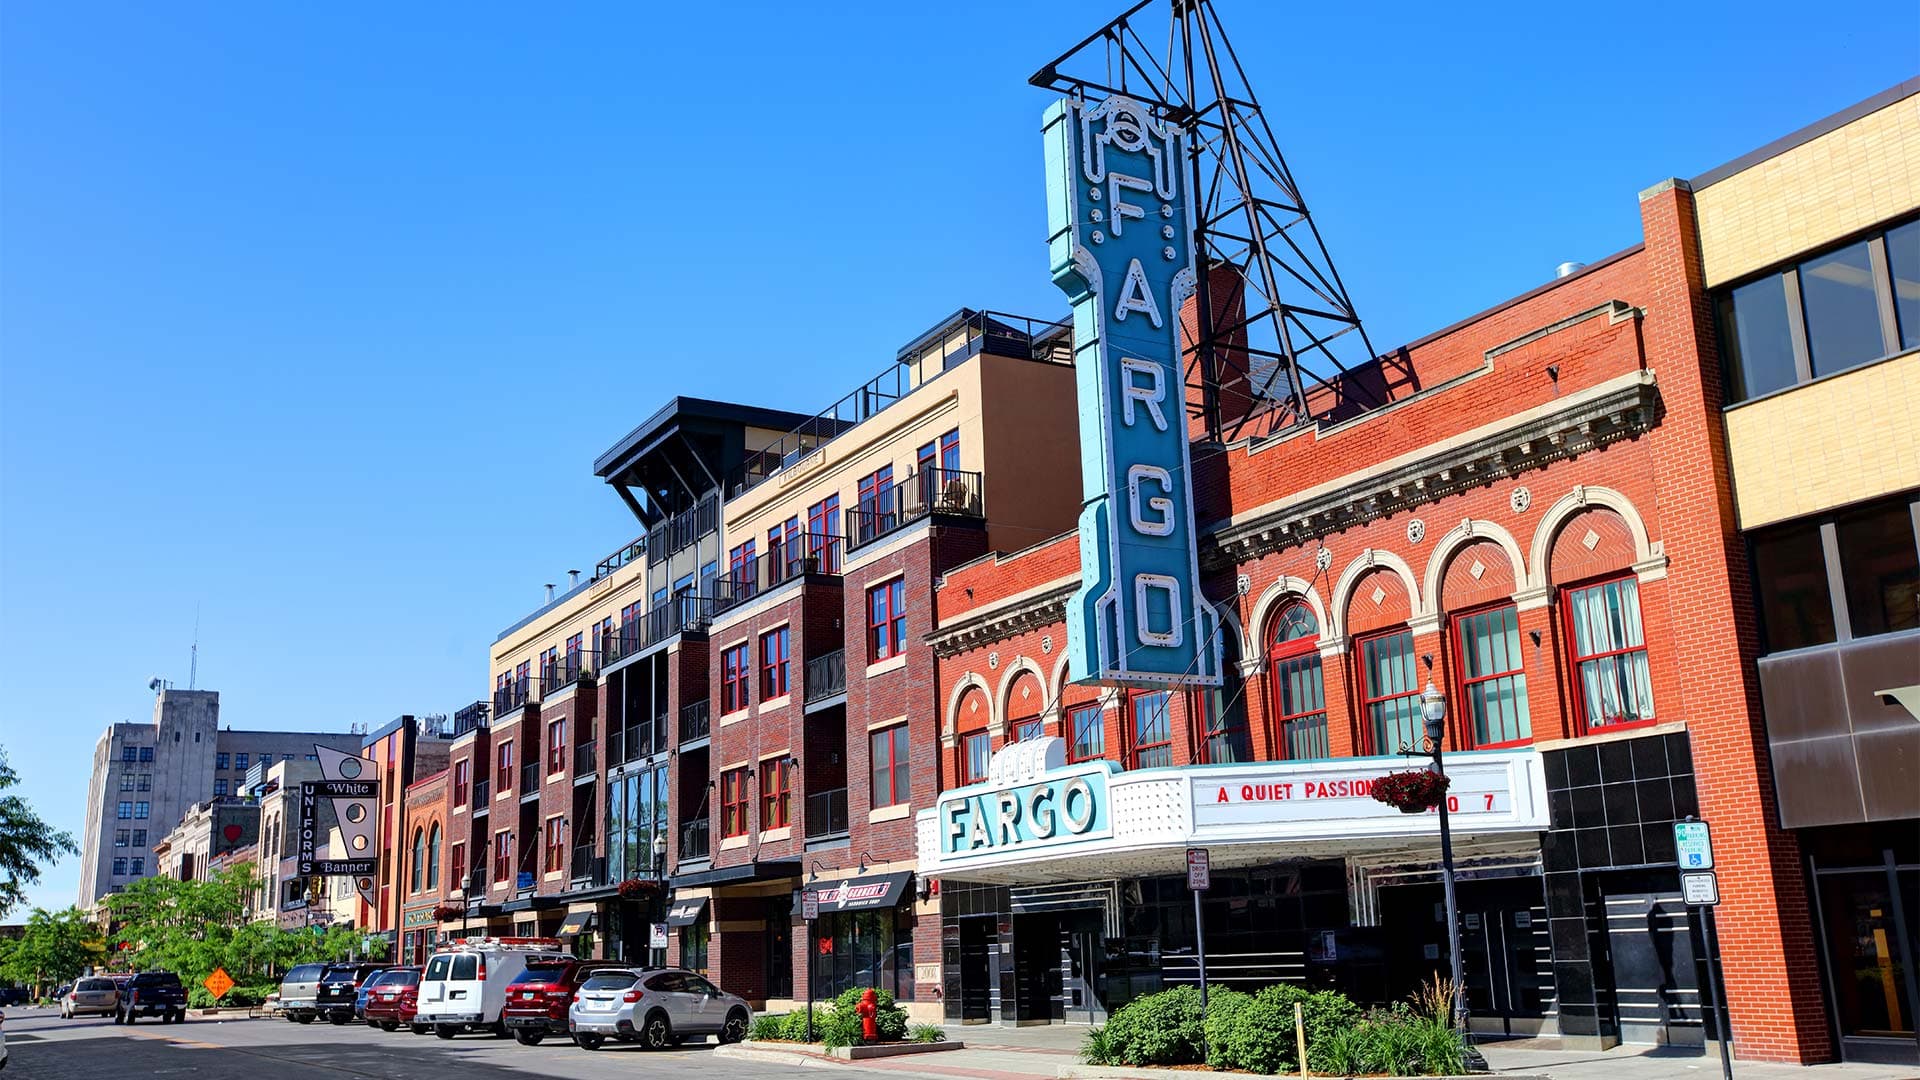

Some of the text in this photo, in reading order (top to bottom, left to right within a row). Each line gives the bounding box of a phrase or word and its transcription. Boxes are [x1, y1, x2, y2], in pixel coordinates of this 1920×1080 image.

[1107, 172, 1183, 648] FARGO
[327, 783, 369, 795] White
[1217, 779, 1376, 803] A QUIET PASSION
[945, 776, 1096, 853] FARGO
[1483, 794, 1495, 811] 7
[302, 785, 315, 874] UNIFORMS
[320, 861, 371, 873] Banner
